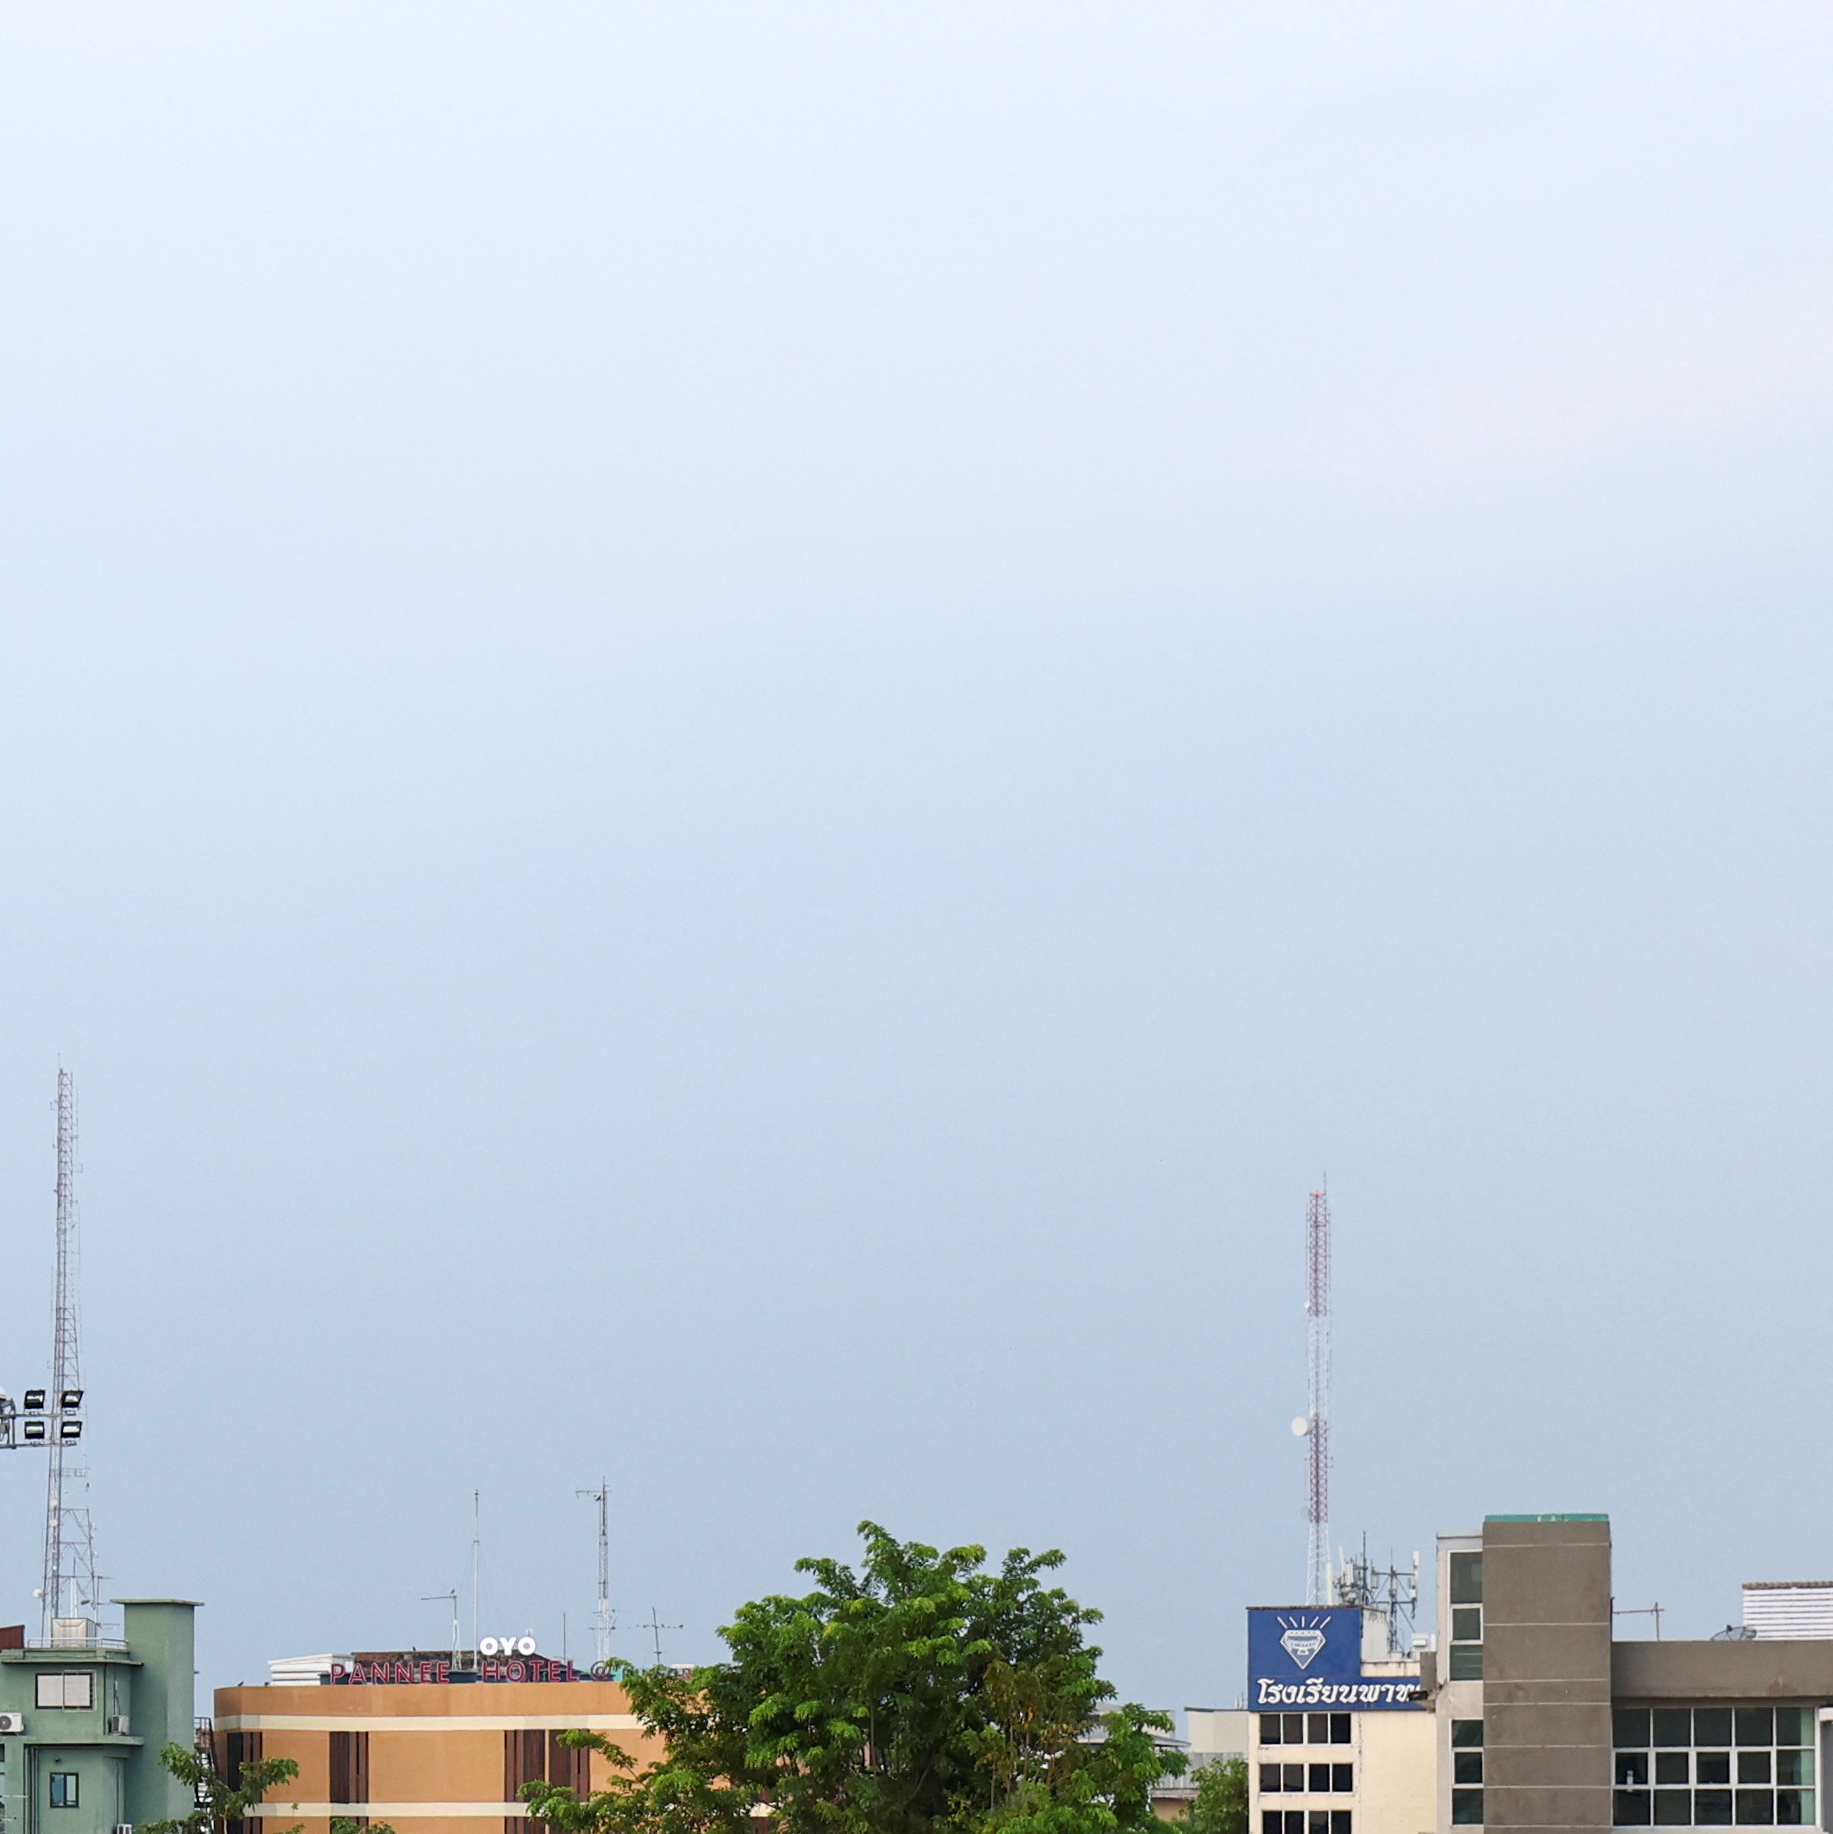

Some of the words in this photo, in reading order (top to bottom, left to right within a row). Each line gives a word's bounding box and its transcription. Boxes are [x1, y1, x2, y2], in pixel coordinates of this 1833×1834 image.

[1257, 1677, 1420, 1704] โรงเรียนพาท
